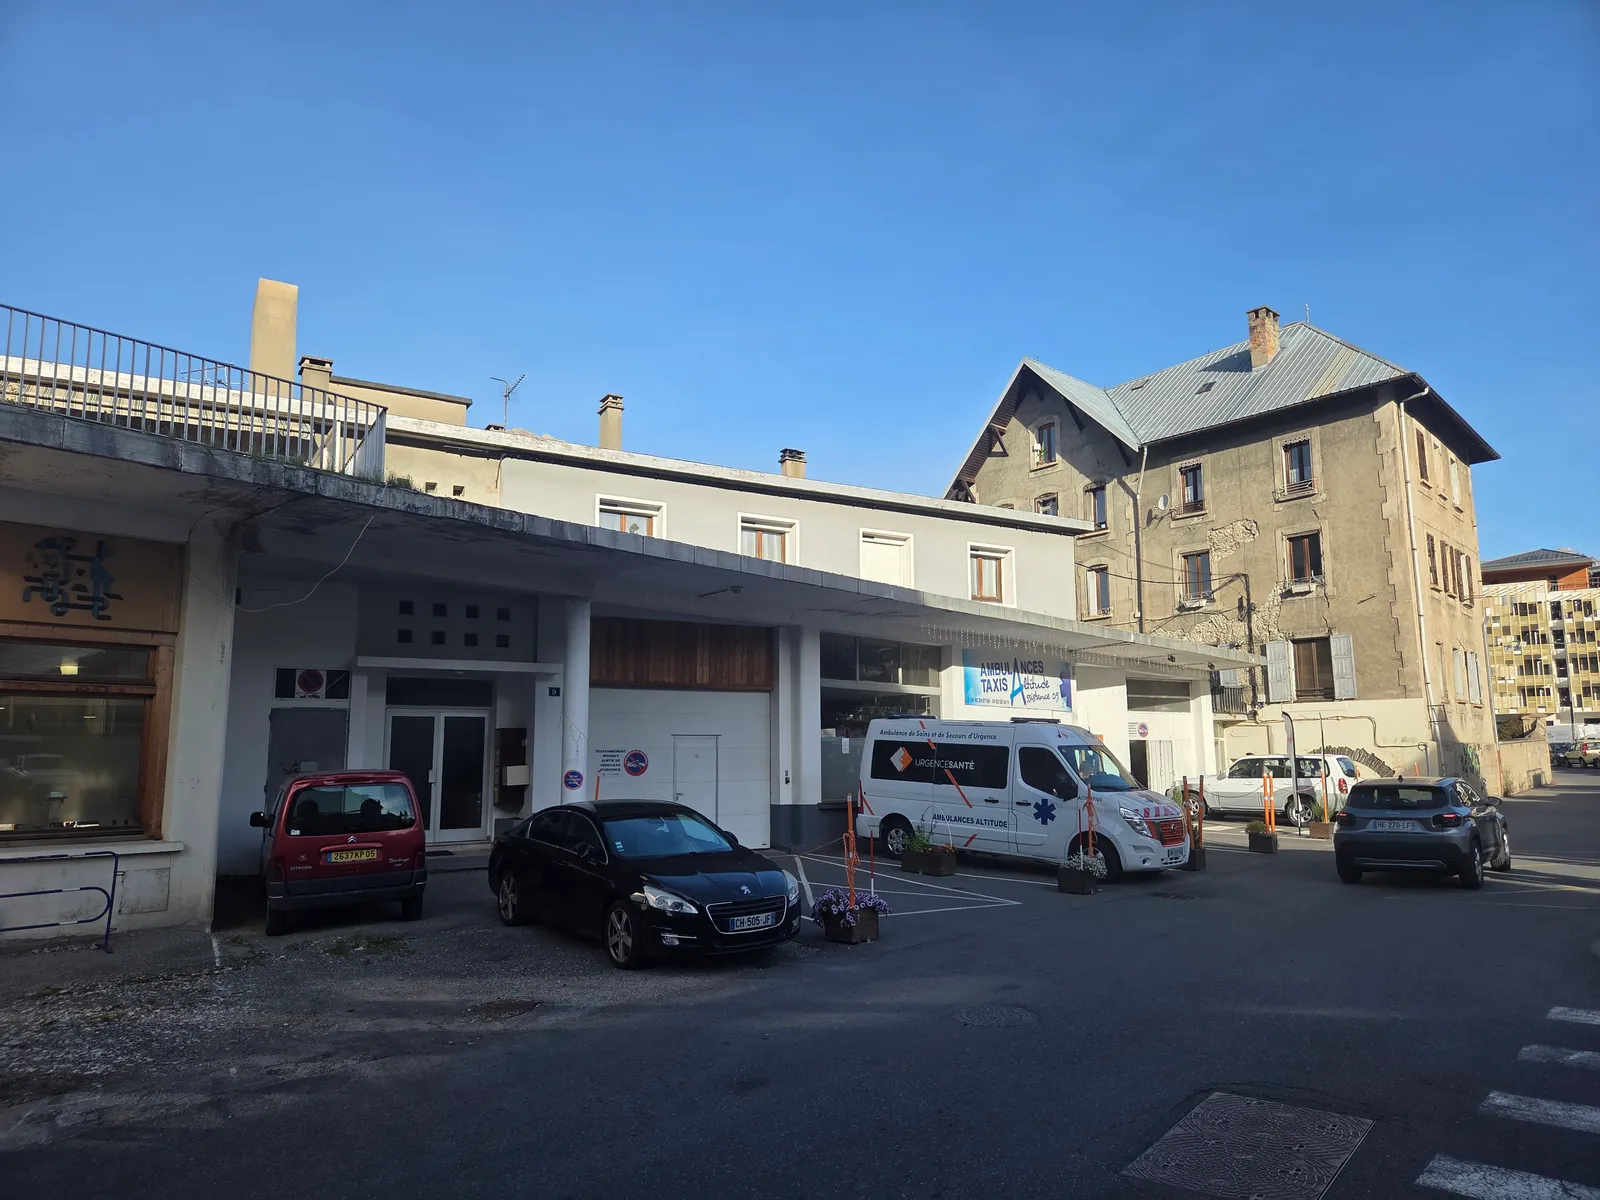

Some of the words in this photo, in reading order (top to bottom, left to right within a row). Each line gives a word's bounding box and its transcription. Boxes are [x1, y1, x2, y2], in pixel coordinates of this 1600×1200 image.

[980, 657, 1045, 677] AMBULANCES
[981, 677, 1009, 692] TAXIS
[968, 733, 997, 741] d'Urgence
[932, 813, 975, 825] AMBULANCES
[976, 818, 1008, 828] ALTITUDE
